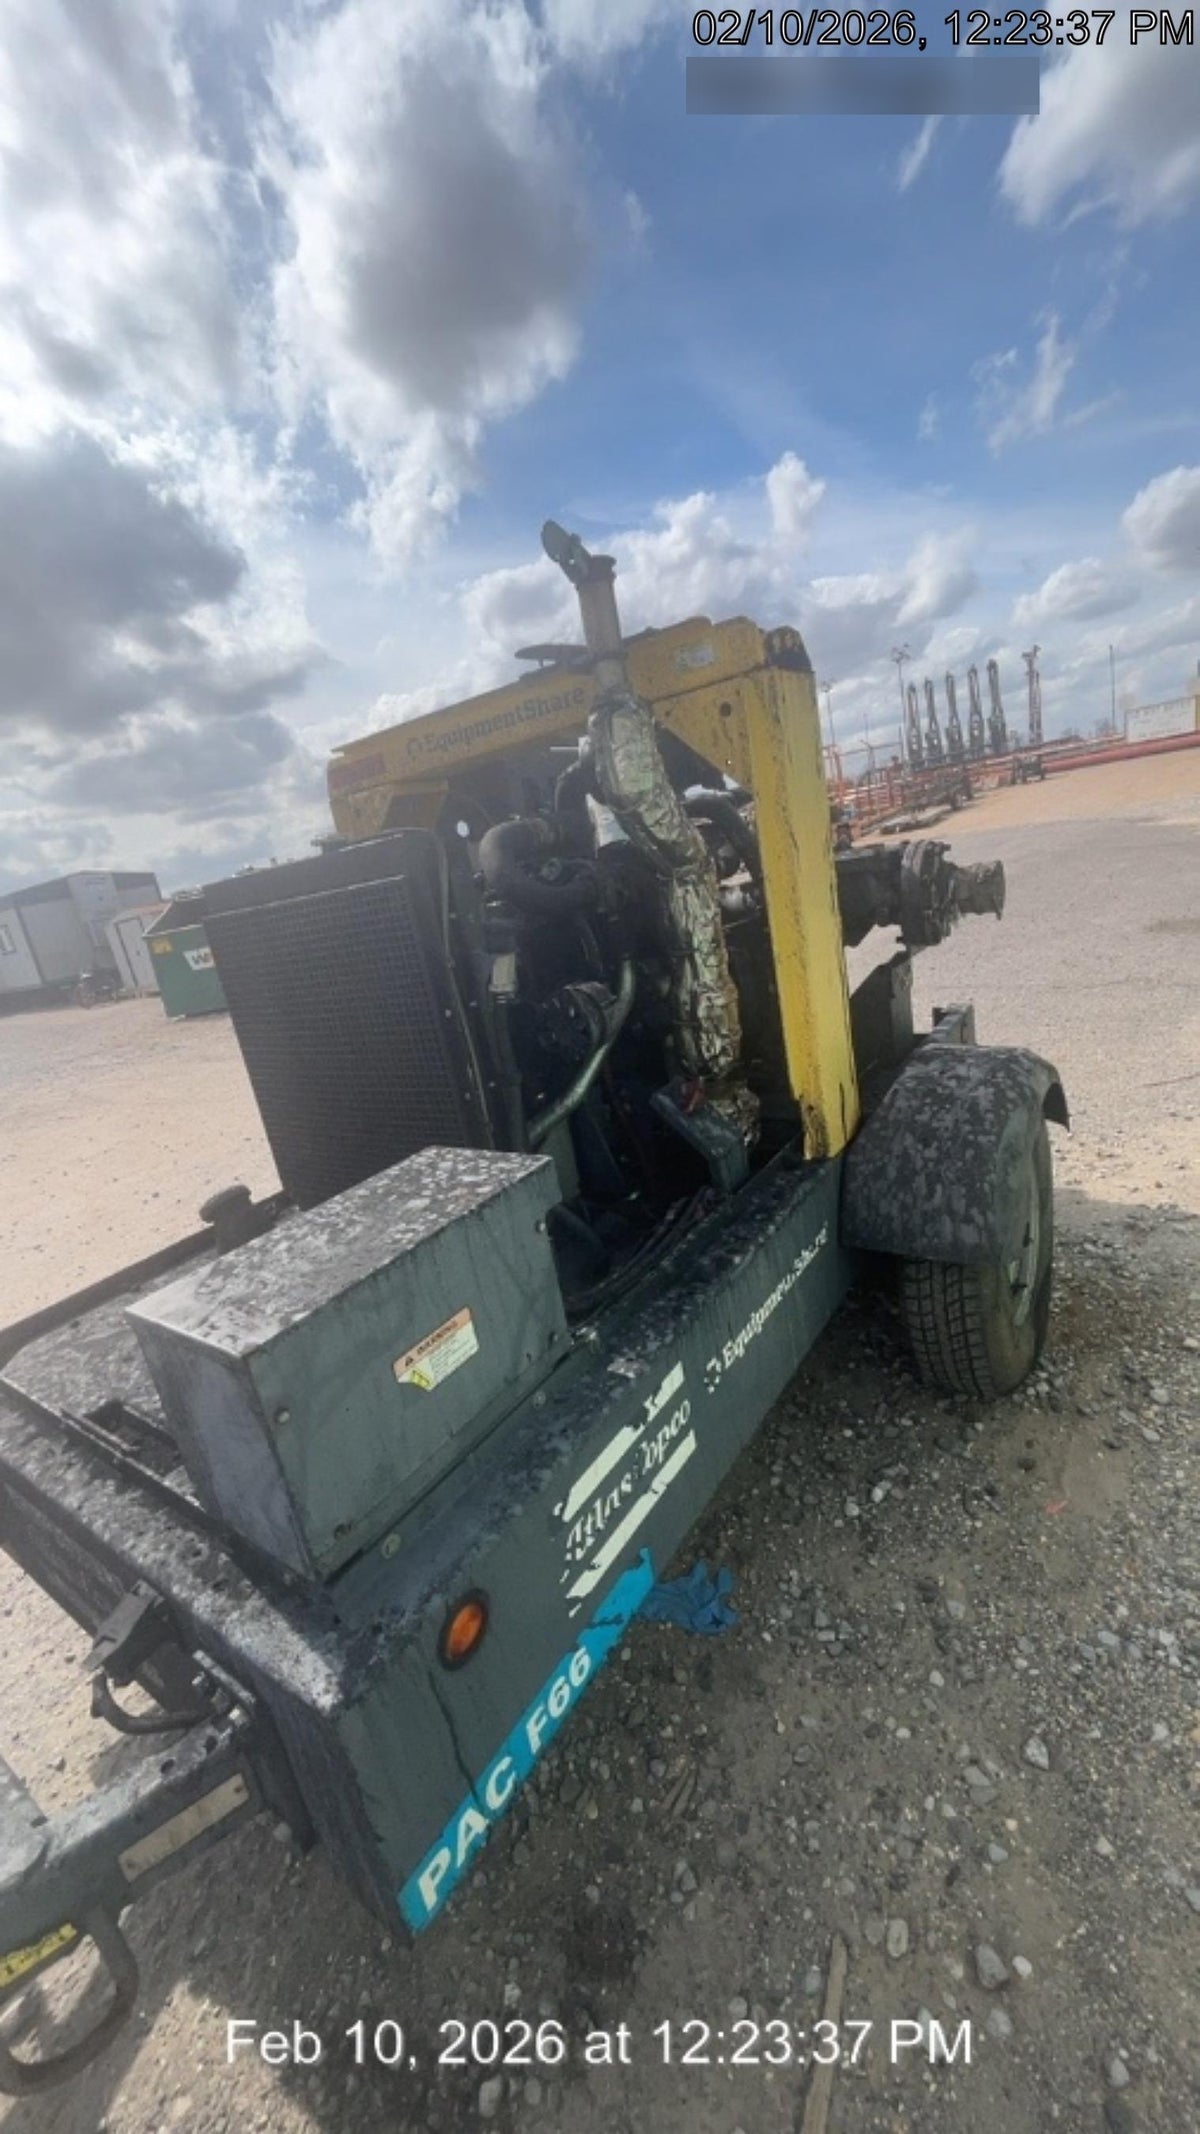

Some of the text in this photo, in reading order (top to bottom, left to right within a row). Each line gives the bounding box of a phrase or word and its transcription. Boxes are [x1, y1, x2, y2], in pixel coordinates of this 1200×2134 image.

[424, 687, 585, 751] EquipmentShare
[418, 1645, 592, 1912] PAC F66
